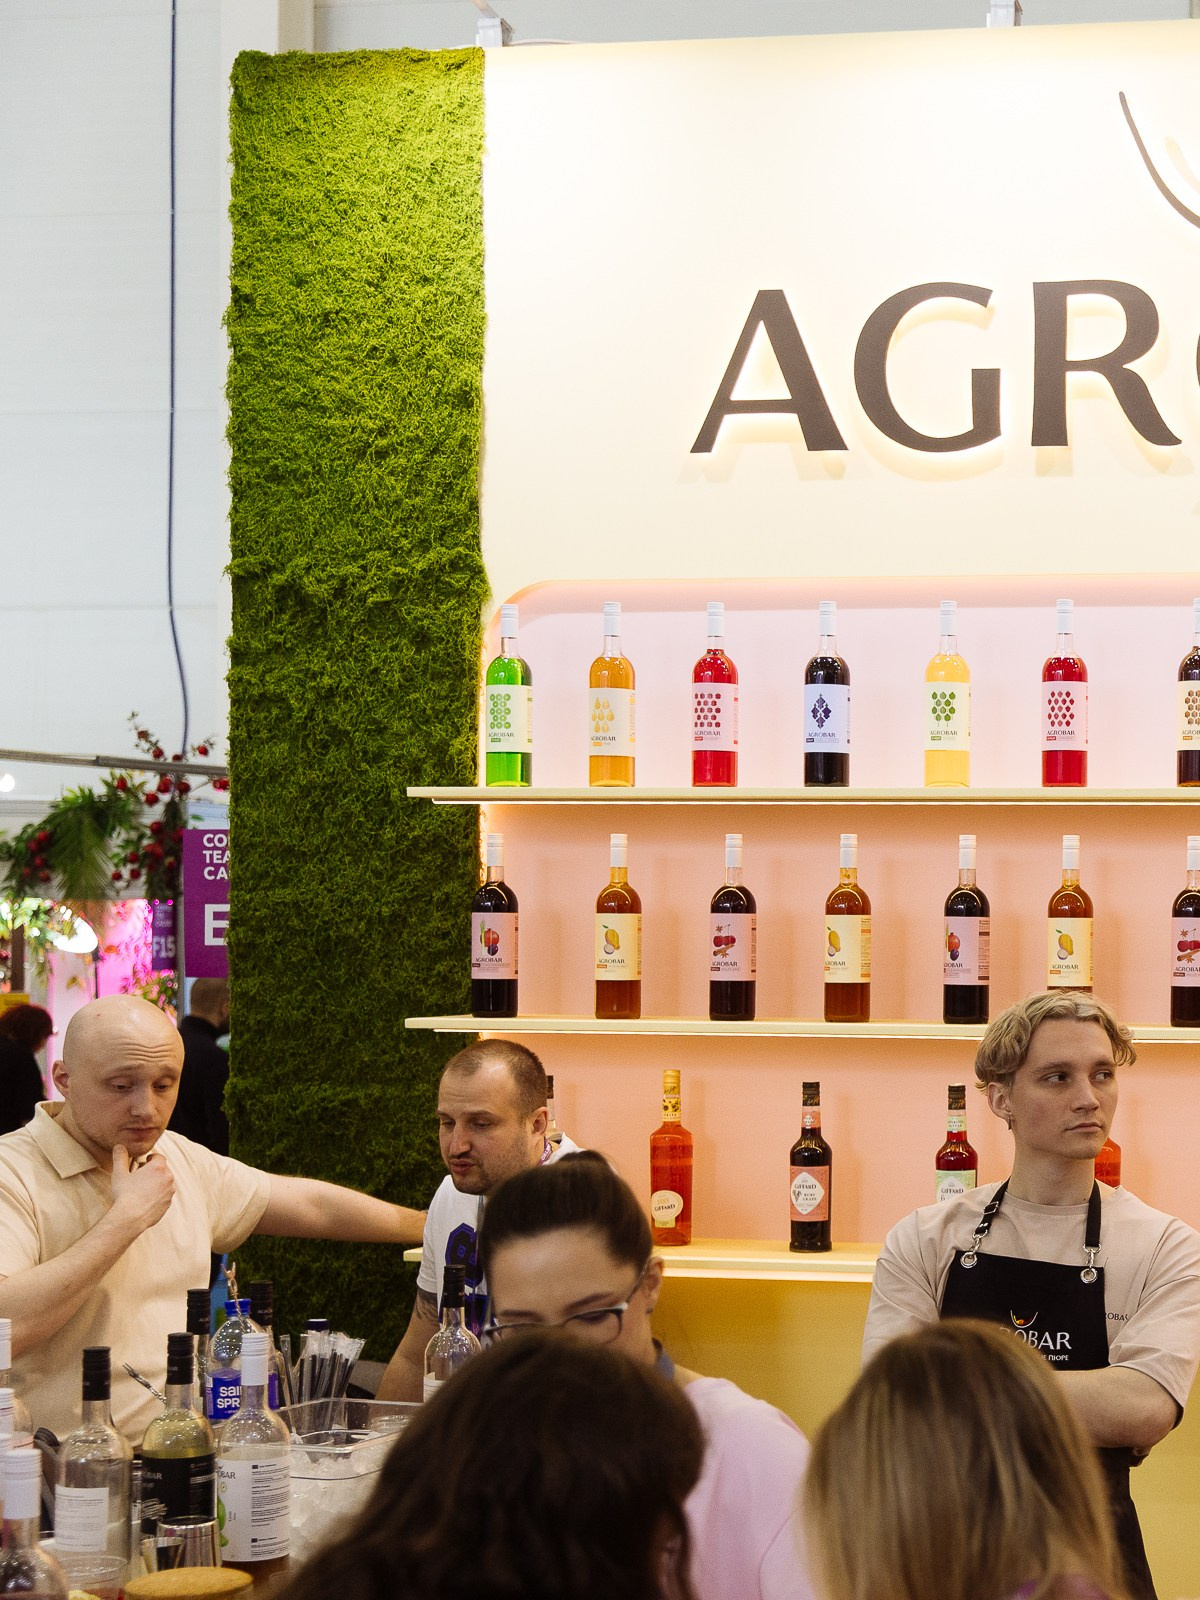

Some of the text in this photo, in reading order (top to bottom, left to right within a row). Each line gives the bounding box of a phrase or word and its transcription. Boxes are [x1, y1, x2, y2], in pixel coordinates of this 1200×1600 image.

[203, 834, 229, 848] CO
[204, 867, 230, 880] CA
[654, 1204, 676, 1212] GIFFARD
[1000, 1328, 1072, 1350] OBAR
[217, 1398, 240, 1408] SPR
[217, 1470, 236, 1479] OBAR
